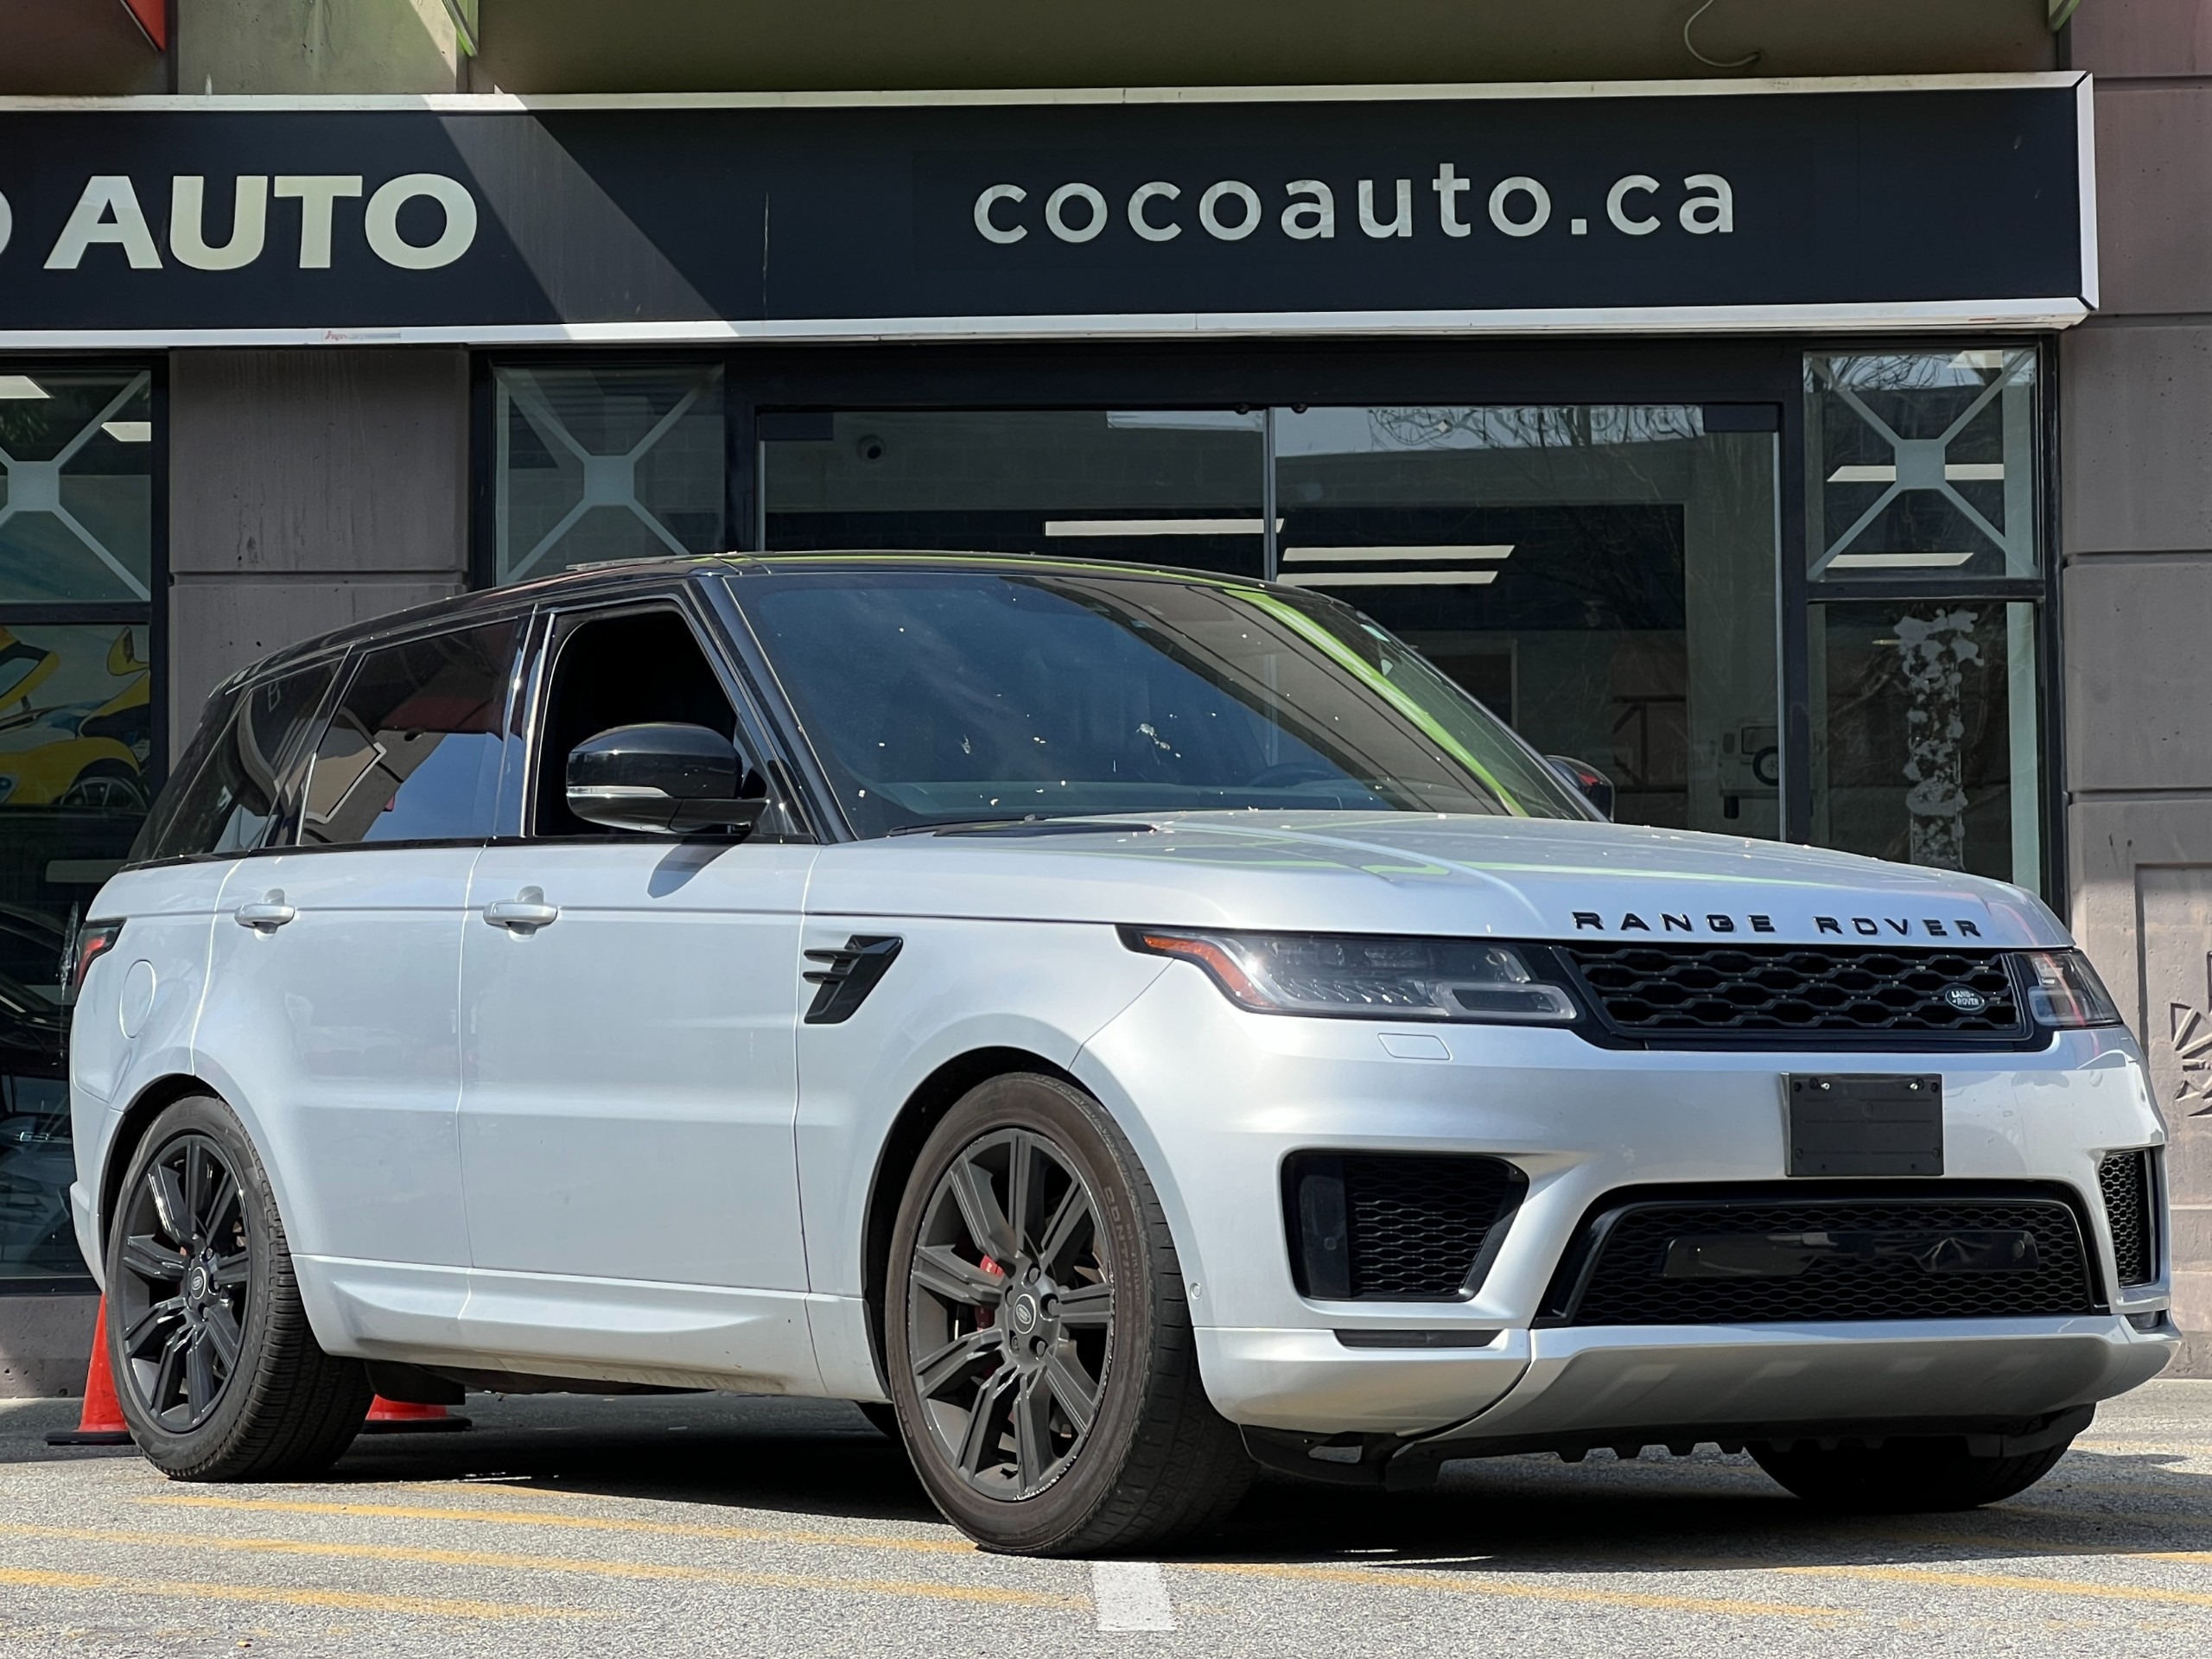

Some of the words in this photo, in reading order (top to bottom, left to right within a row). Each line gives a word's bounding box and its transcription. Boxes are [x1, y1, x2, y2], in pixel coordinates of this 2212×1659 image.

[43, 174, 478, 270] AUTO
[974, 162, 1734, 244] cocoauto.ca
[1572, 912, 1776, 933] RANGE
[1813, 916, 1982, 938] ROVER
[1956, 997, 1980, 1006] ROVER
